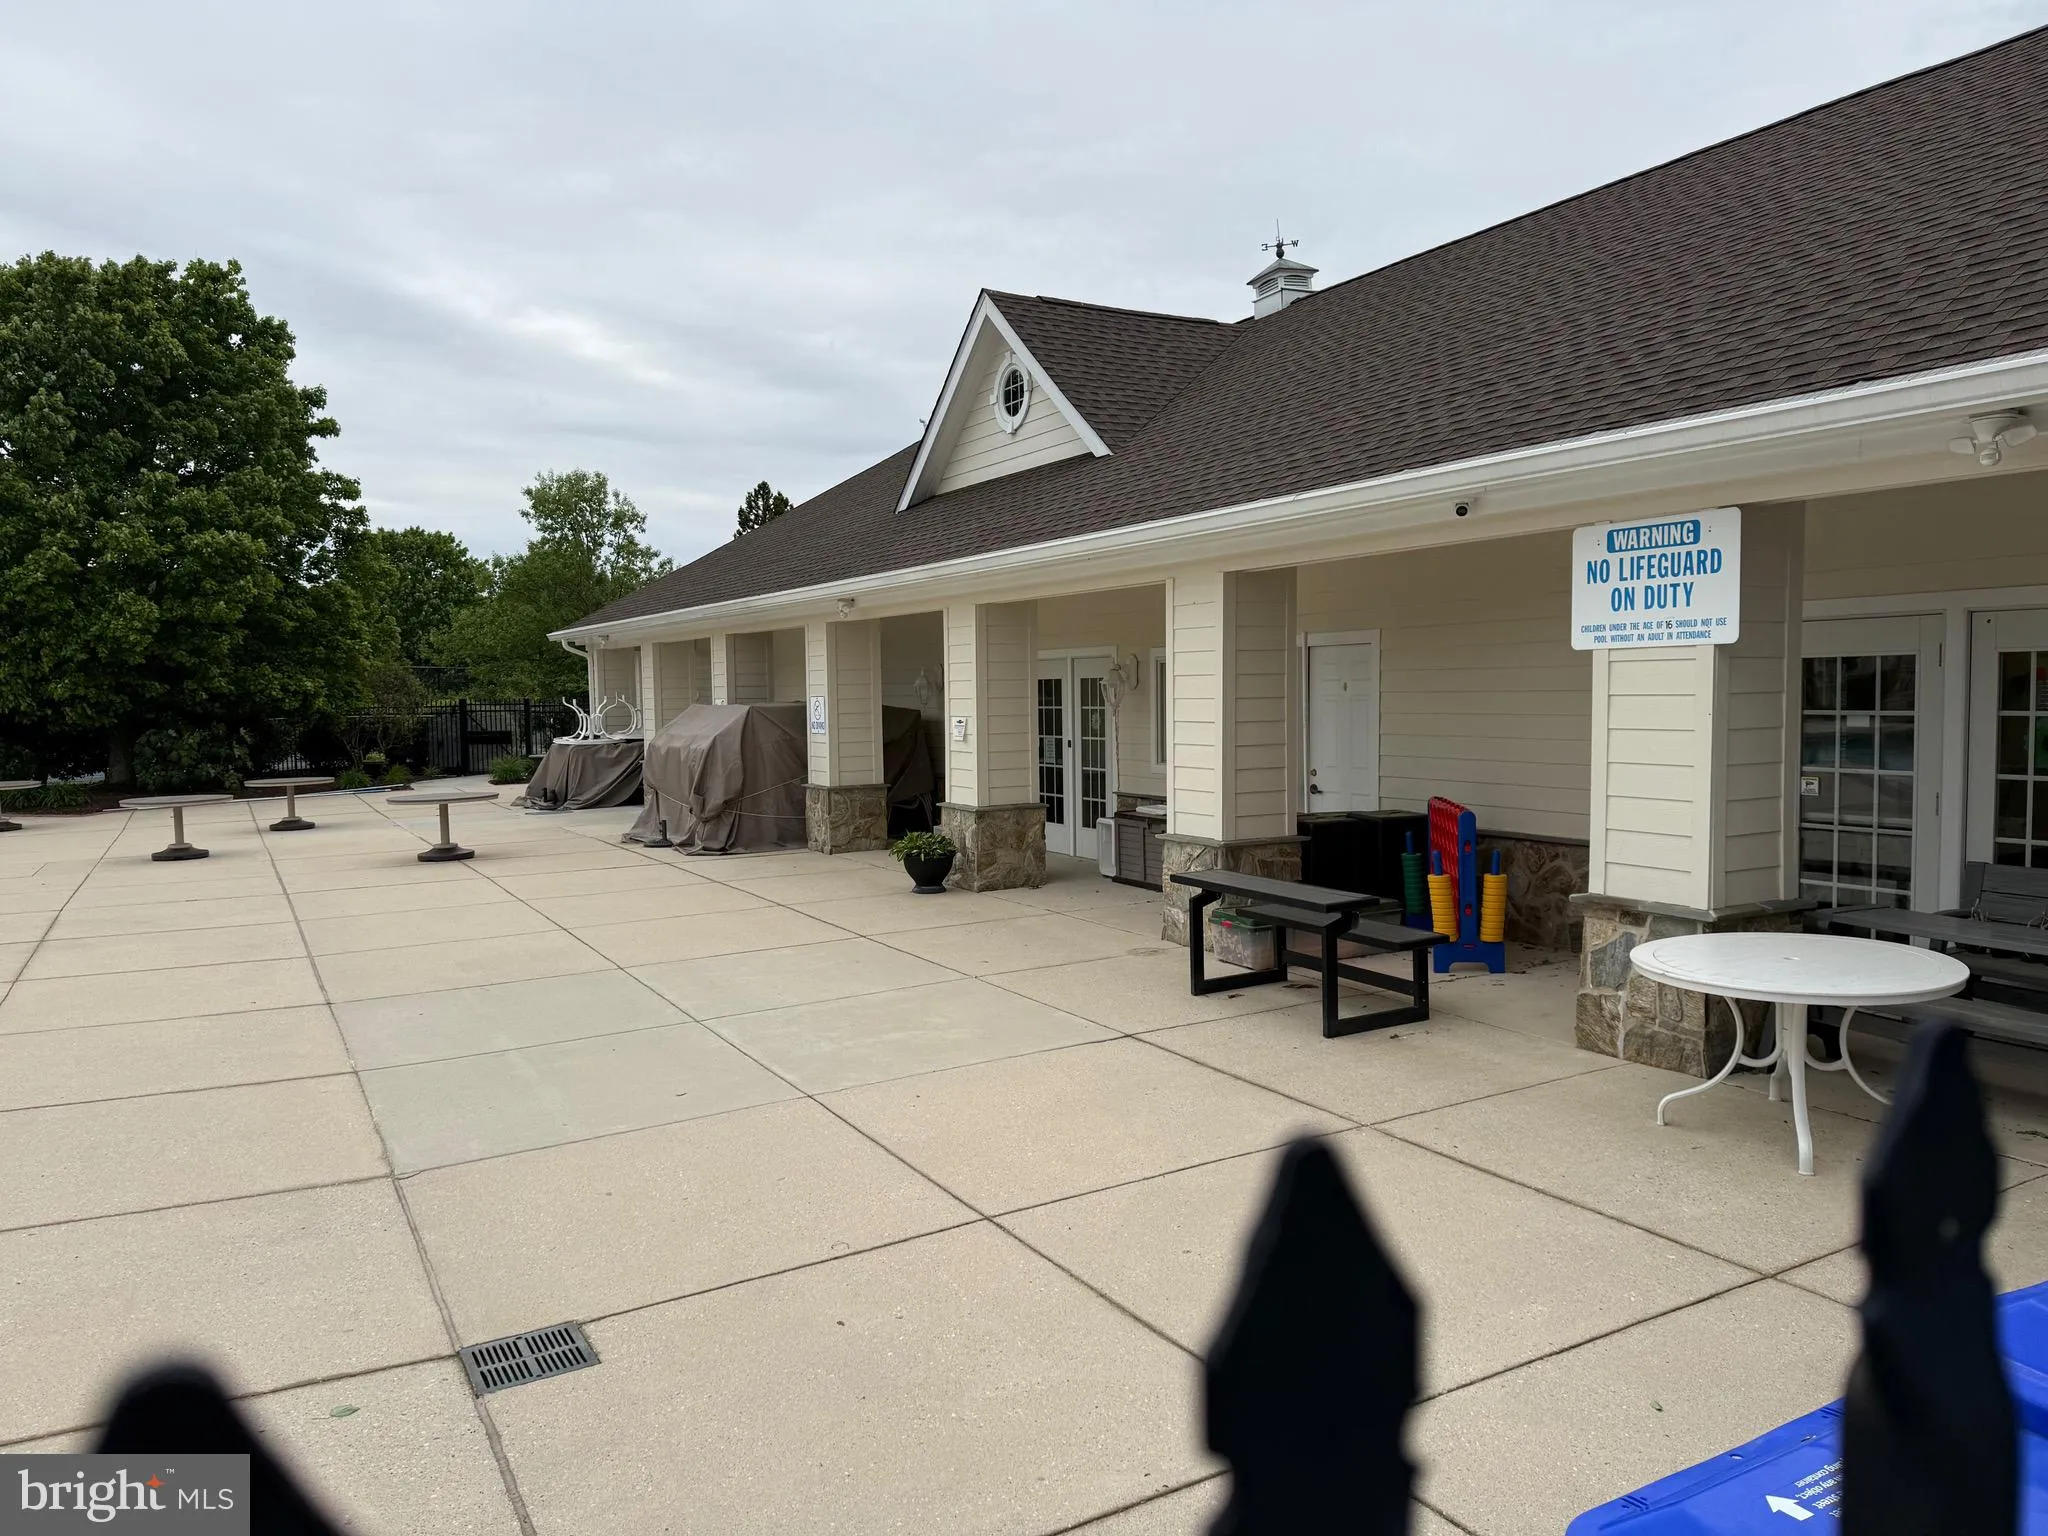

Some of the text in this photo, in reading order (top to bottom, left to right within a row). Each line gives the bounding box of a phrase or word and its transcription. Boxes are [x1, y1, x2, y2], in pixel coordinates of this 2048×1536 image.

[1613, 522, 1694, 551] WARNING
[1587, 548, 1722, 584] NO LIFEGUARD
[1611, 582, 1695, 612] ON DUTY
[1581, 617, 1728, 633] CHILDREN UNDER THE AGE OF 16 SHOULD NOT USE
[1593, 630, 1711, 643] POOL WITHOUT AN ADULT IN ATTENDANCE
